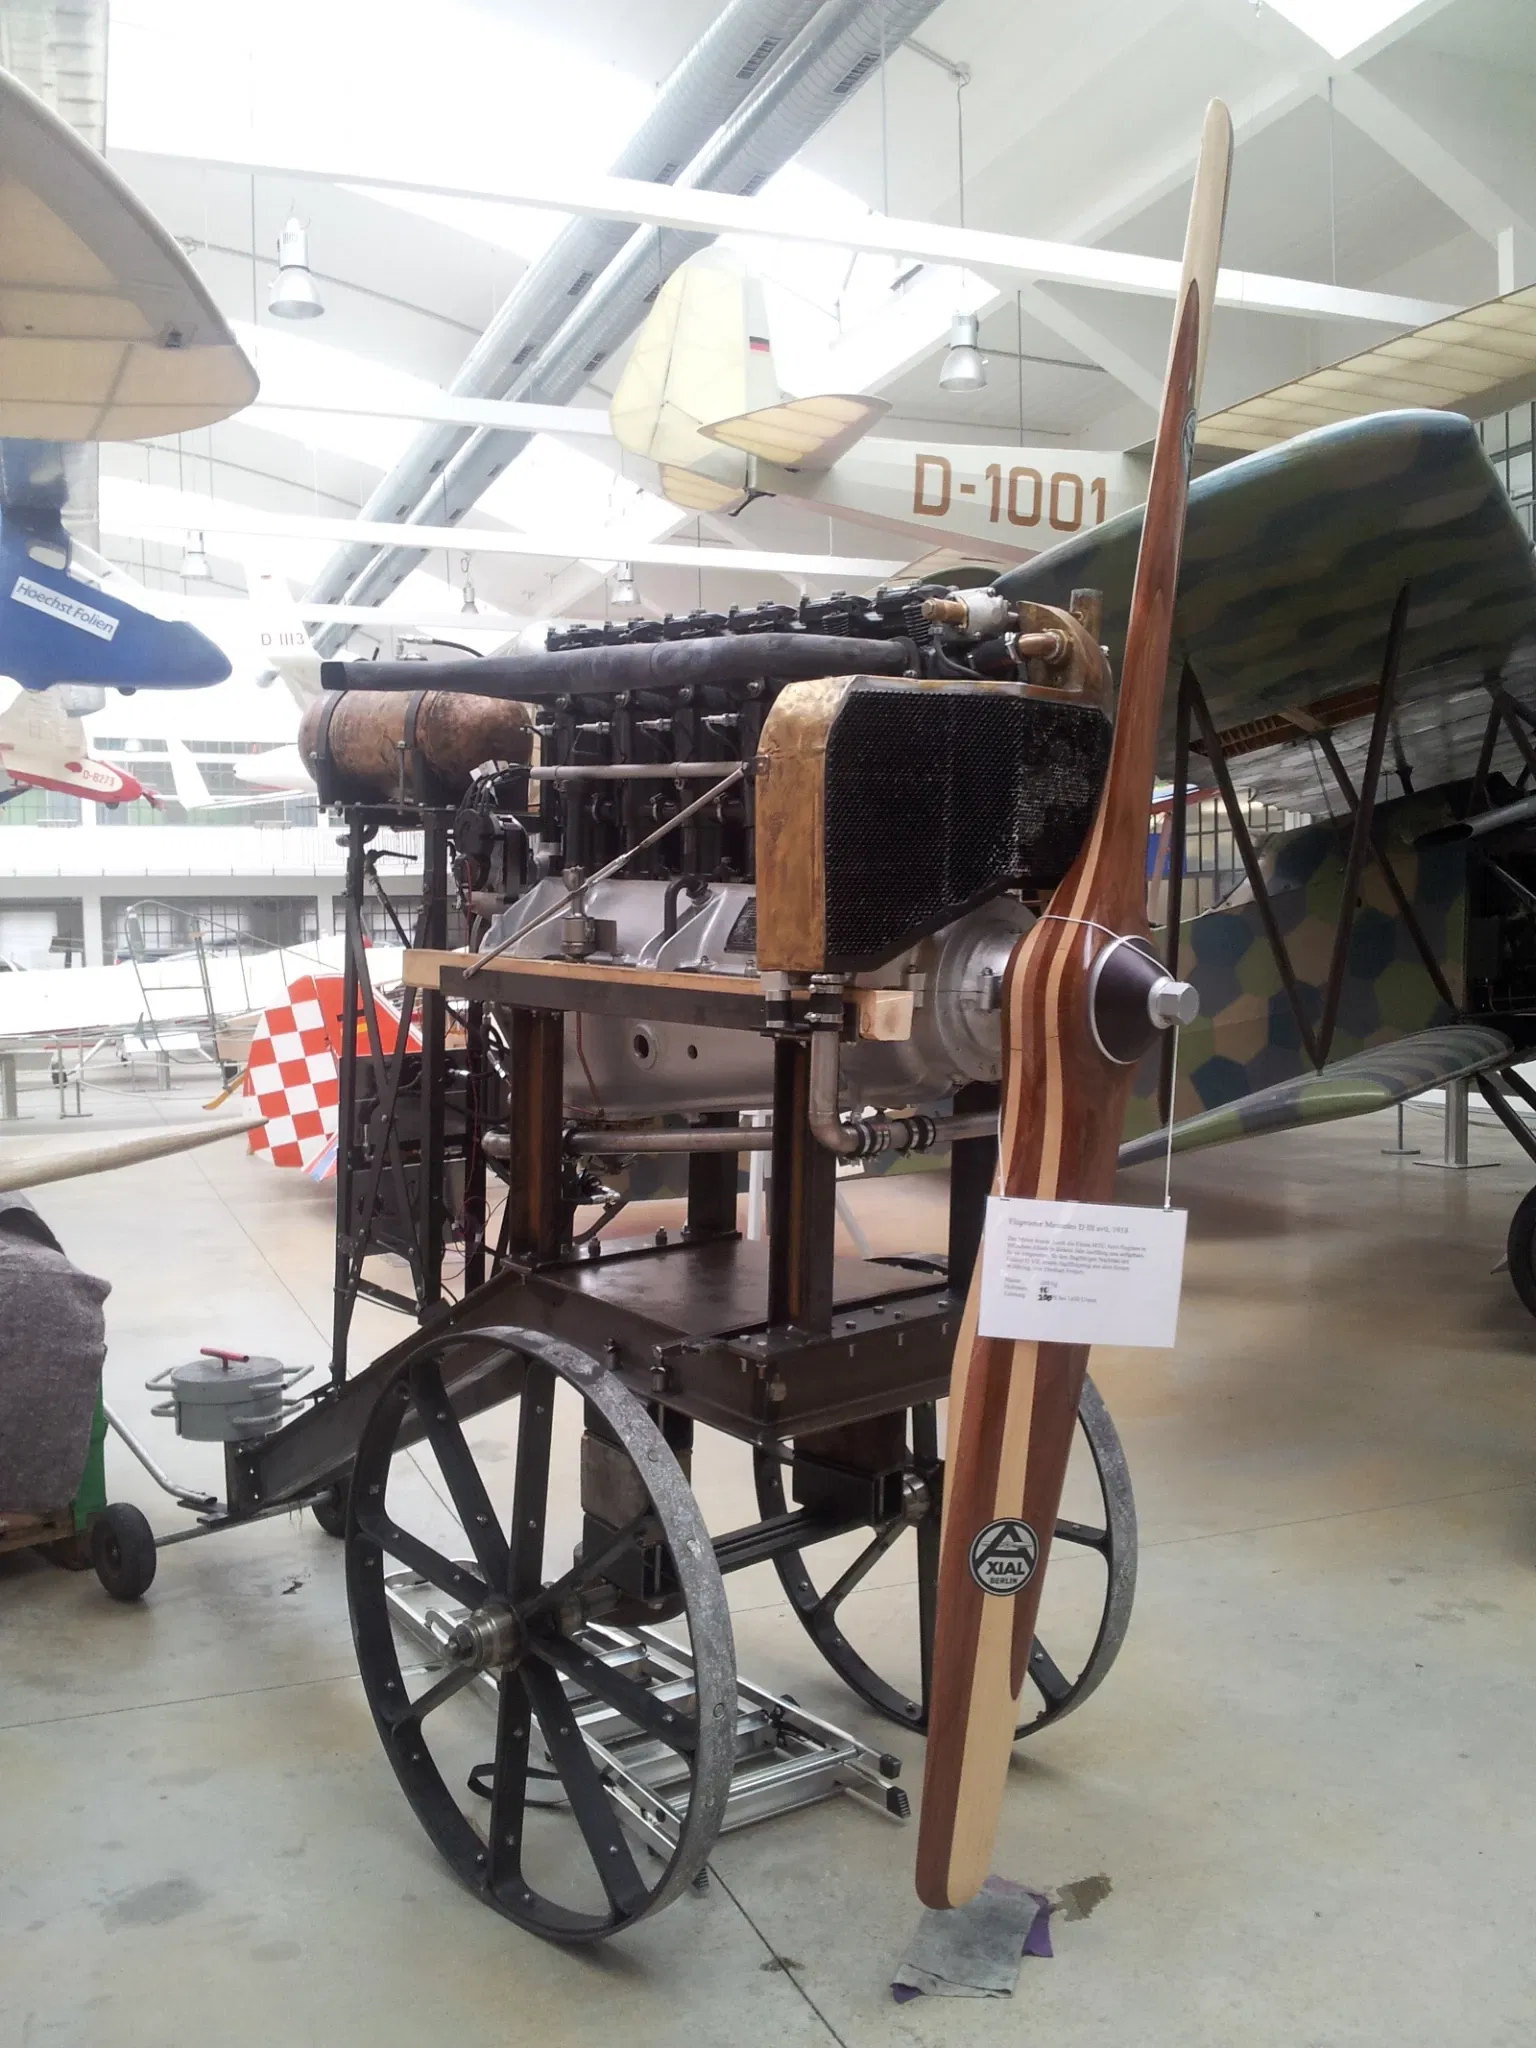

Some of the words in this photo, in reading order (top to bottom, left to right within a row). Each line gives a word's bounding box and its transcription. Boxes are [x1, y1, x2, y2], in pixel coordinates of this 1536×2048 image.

[913, 453, 1106, 532] D-1001
[17, 582, 74, 616] Hoechst
[73, 607, 114, 634] Folien
[261, 632, 272, 646] D
[989, 1577, 1018, 1585] BERLIN
